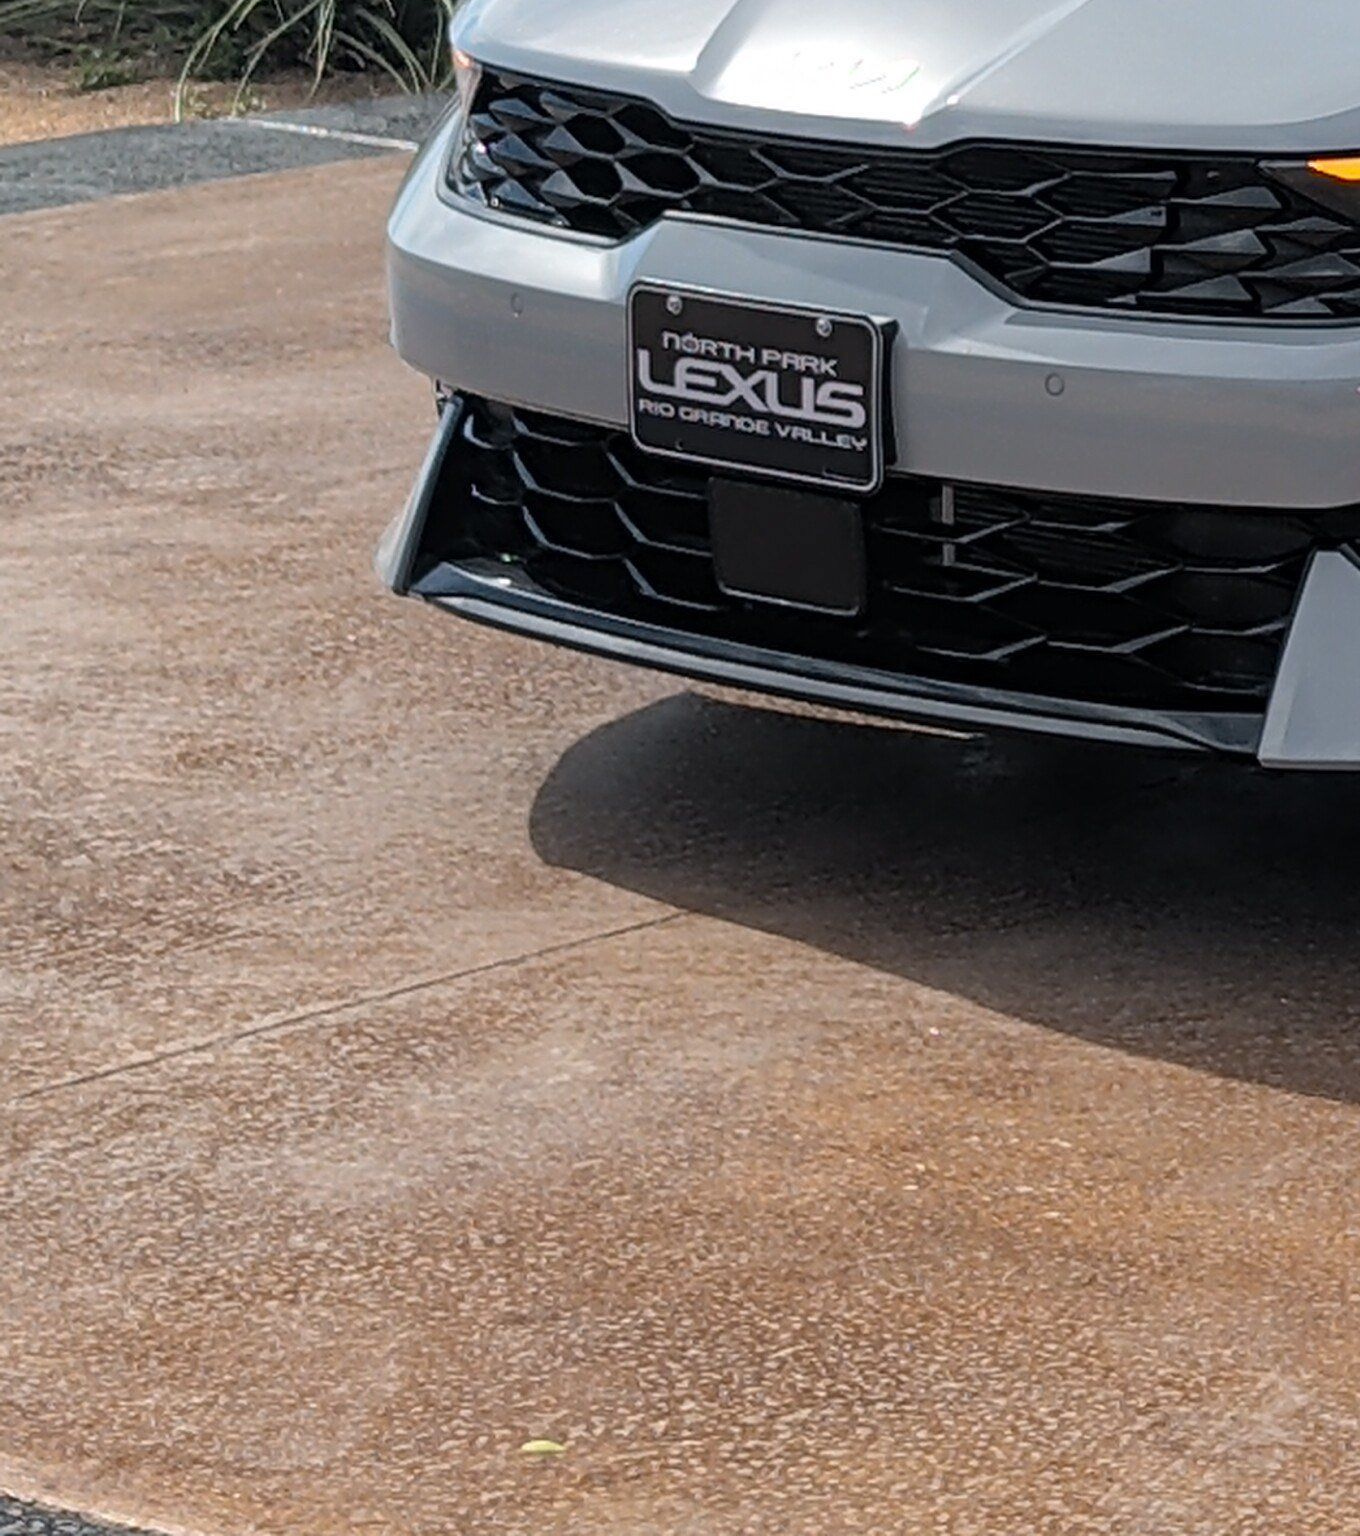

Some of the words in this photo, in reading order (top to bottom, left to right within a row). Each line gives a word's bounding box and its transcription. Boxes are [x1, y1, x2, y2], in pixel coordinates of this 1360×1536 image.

[661, 330, 756, 364] NORTH
[760, 348, 838, 378] PARK
[636, 347, 867, 429] LEXUS
[638, 397, 676, 419] RIO
[678, 407, 771, 436] GRANDE
[773, 421, 869, 453] VALLEY
